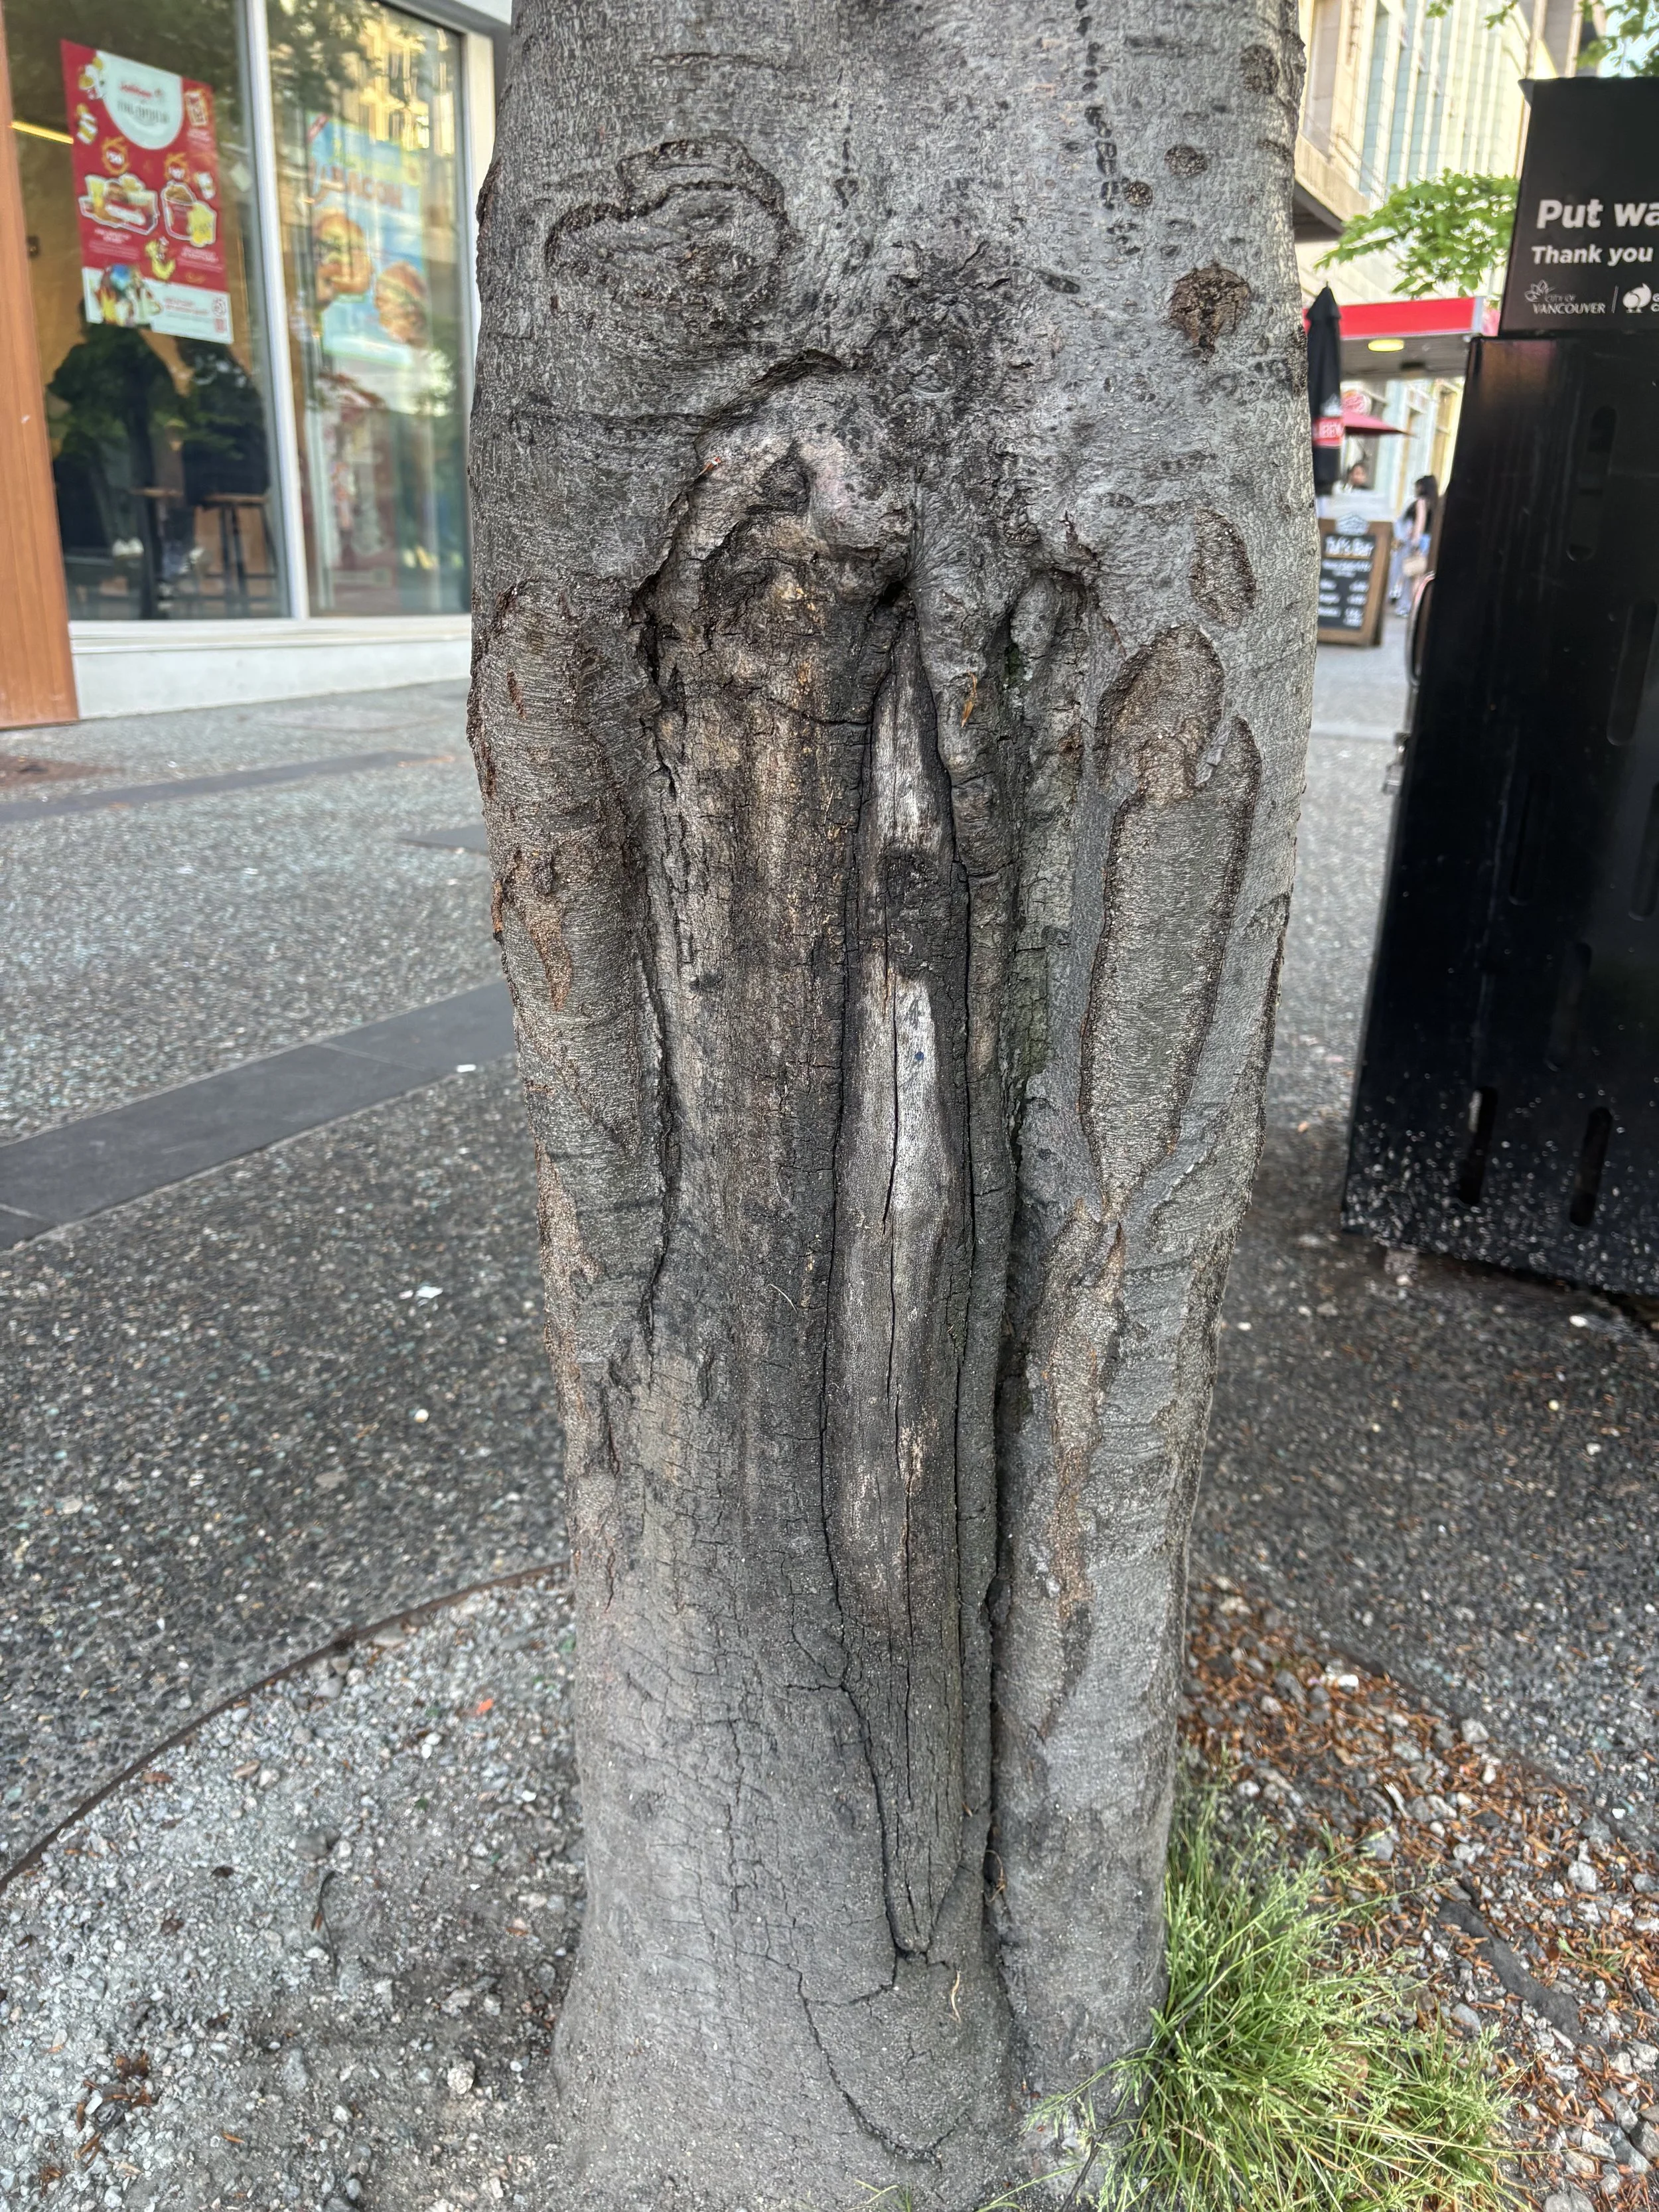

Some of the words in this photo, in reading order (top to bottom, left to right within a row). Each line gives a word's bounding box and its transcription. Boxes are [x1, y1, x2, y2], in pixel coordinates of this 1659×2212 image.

[1536, 198, 1604, 229] Put
[1531, 244, 1603, 264] Thank
[1607, 247, 1654, 266] you
[1532, 303, 1606, 314] VANCOUVER
